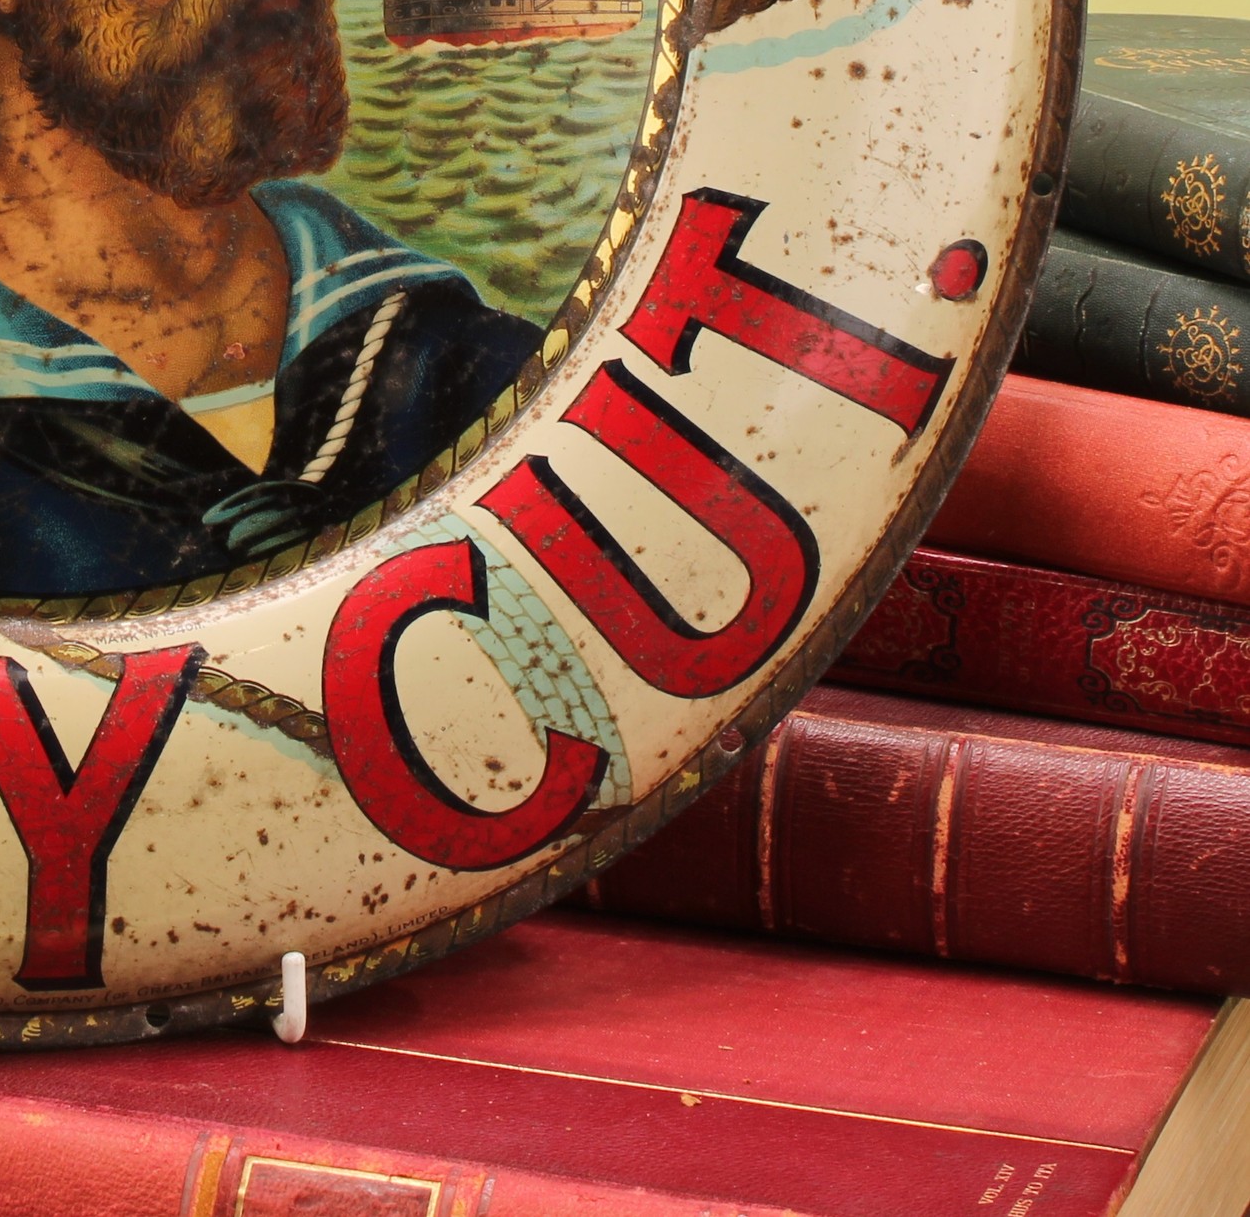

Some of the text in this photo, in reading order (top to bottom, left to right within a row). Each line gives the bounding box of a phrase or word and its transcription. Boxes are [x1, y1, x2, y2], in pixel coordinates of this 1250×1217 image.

[95, 631, 140, 645] MARK
[13, 994, 95, 1007] COMPANY
[137, 982, 194, 998] GREAT
[201, 965, 275, 986] BRITAIN
[978, 1163, 1015, 1204] VOL. XIV
[1022, 1181, 1044, 1195] TO
